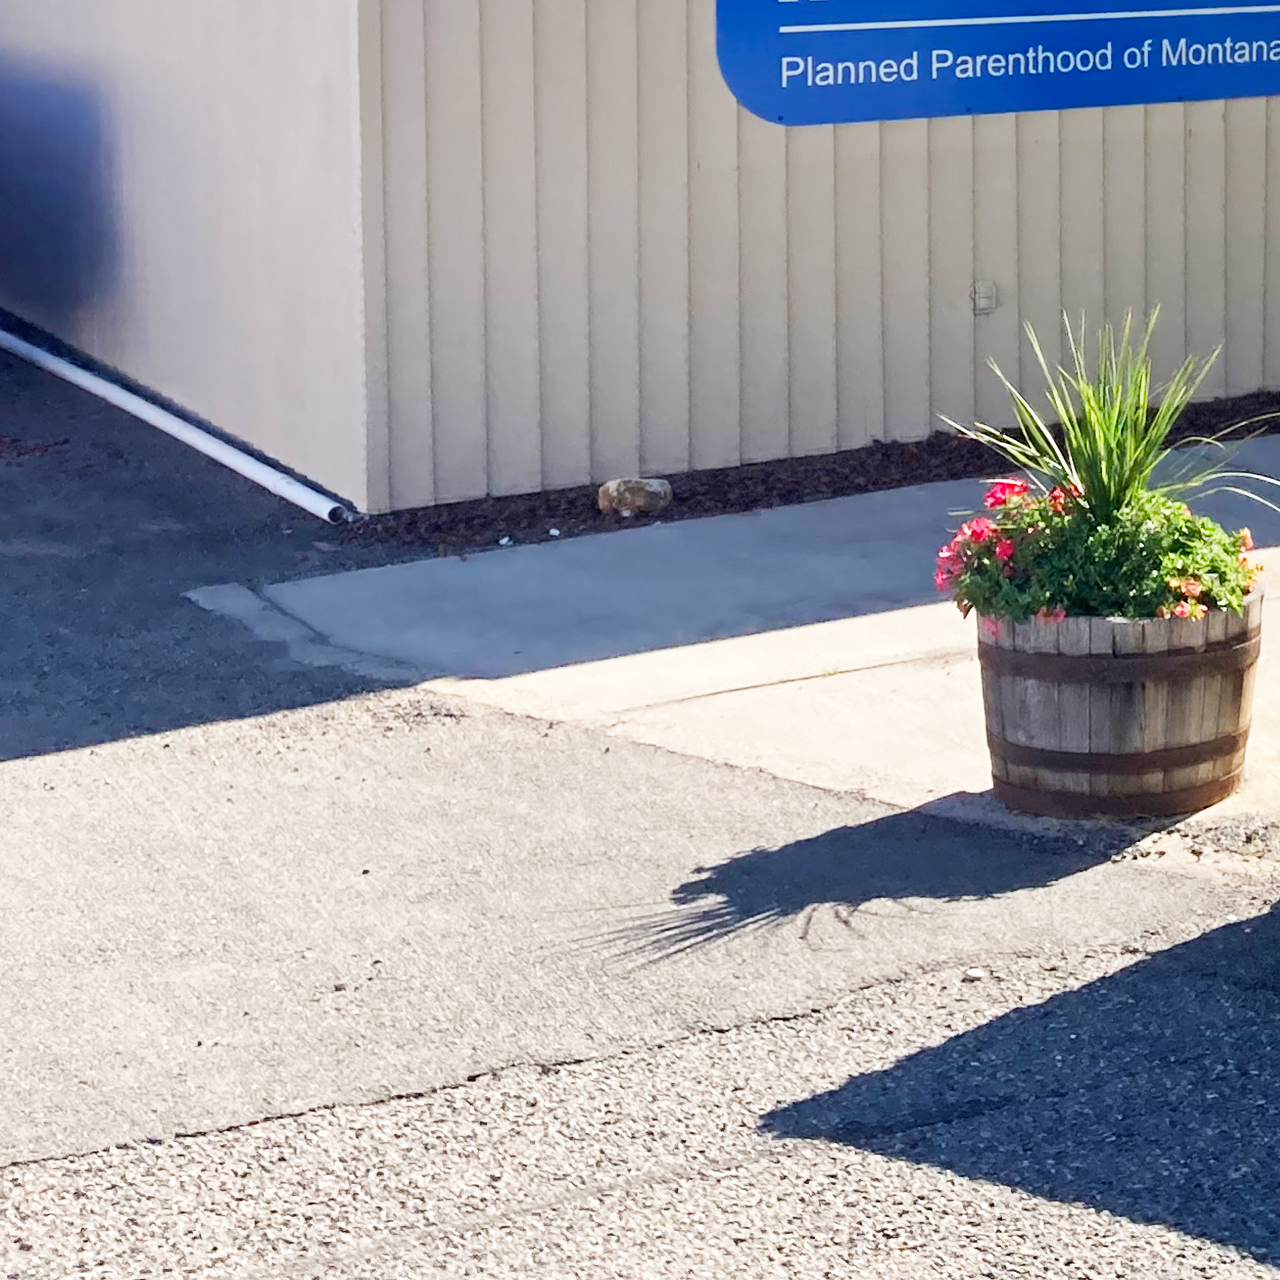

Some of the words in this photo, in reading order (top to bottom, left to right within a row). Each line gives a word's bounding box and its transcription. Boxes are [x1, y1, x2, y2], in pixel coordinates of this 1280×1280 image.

[781, 51, 918, 88] Planned
[931, 41, 1112, 80] Parenthood
[1123, 39, 1153, 69] of
